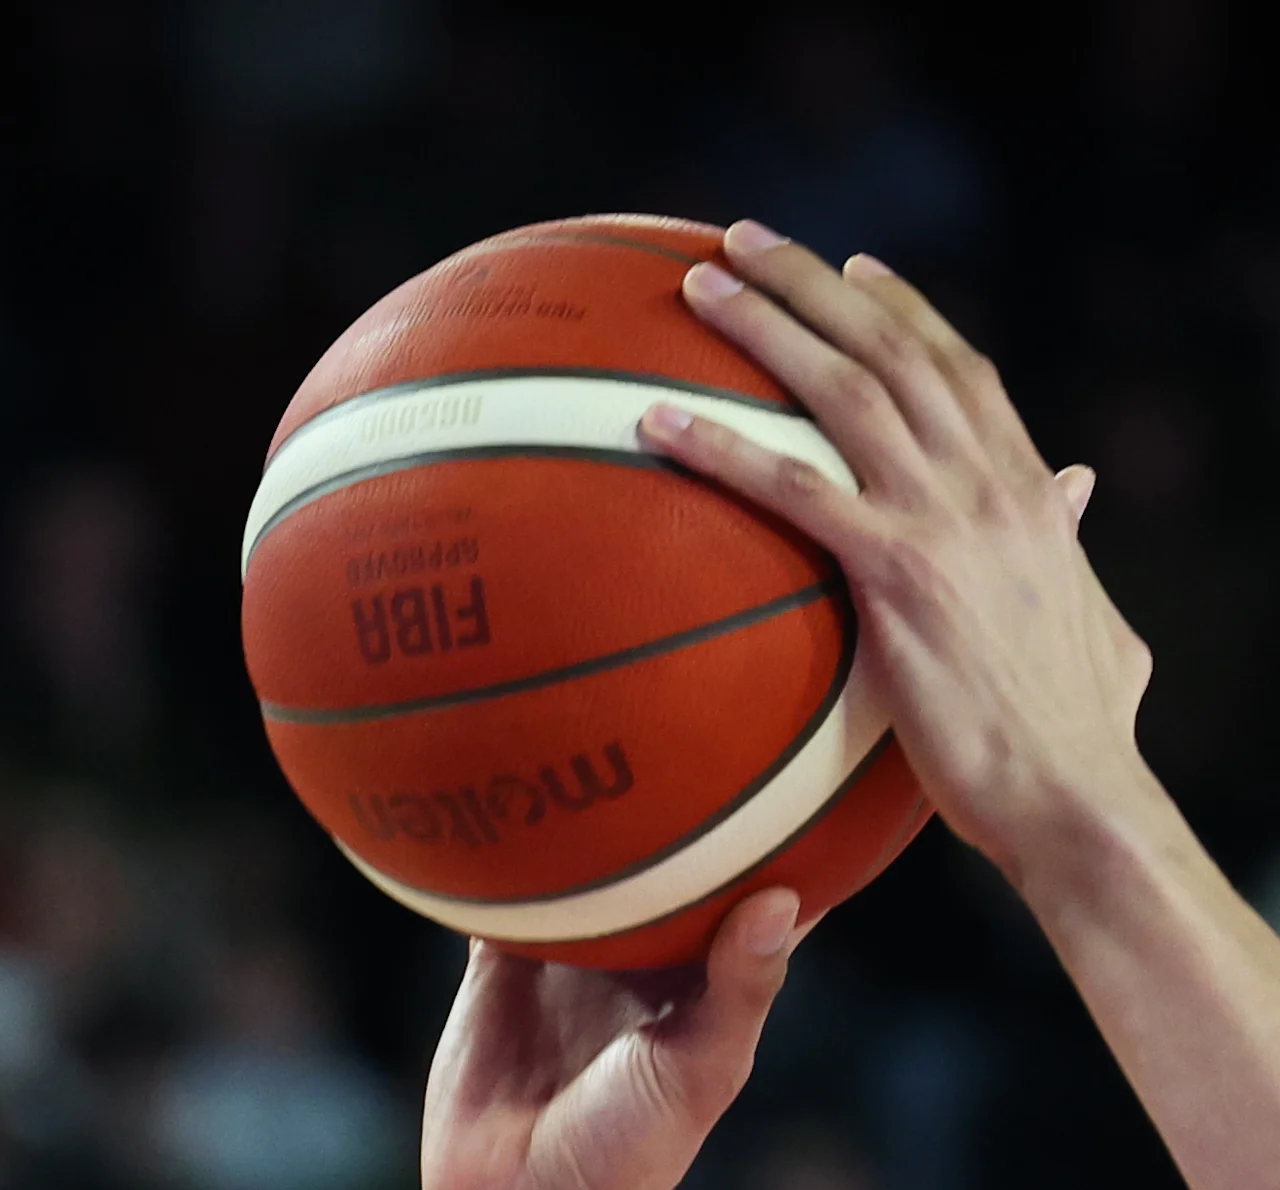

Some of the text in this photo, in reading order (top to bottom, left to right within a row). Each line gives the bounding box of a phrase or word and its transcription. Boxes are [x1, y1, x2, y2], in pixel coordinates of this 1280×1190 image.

[345, 537, 480, 589] APPROVED
[350, 574, 492, 668] FIBA
[348, 738, 635, 853] molten
